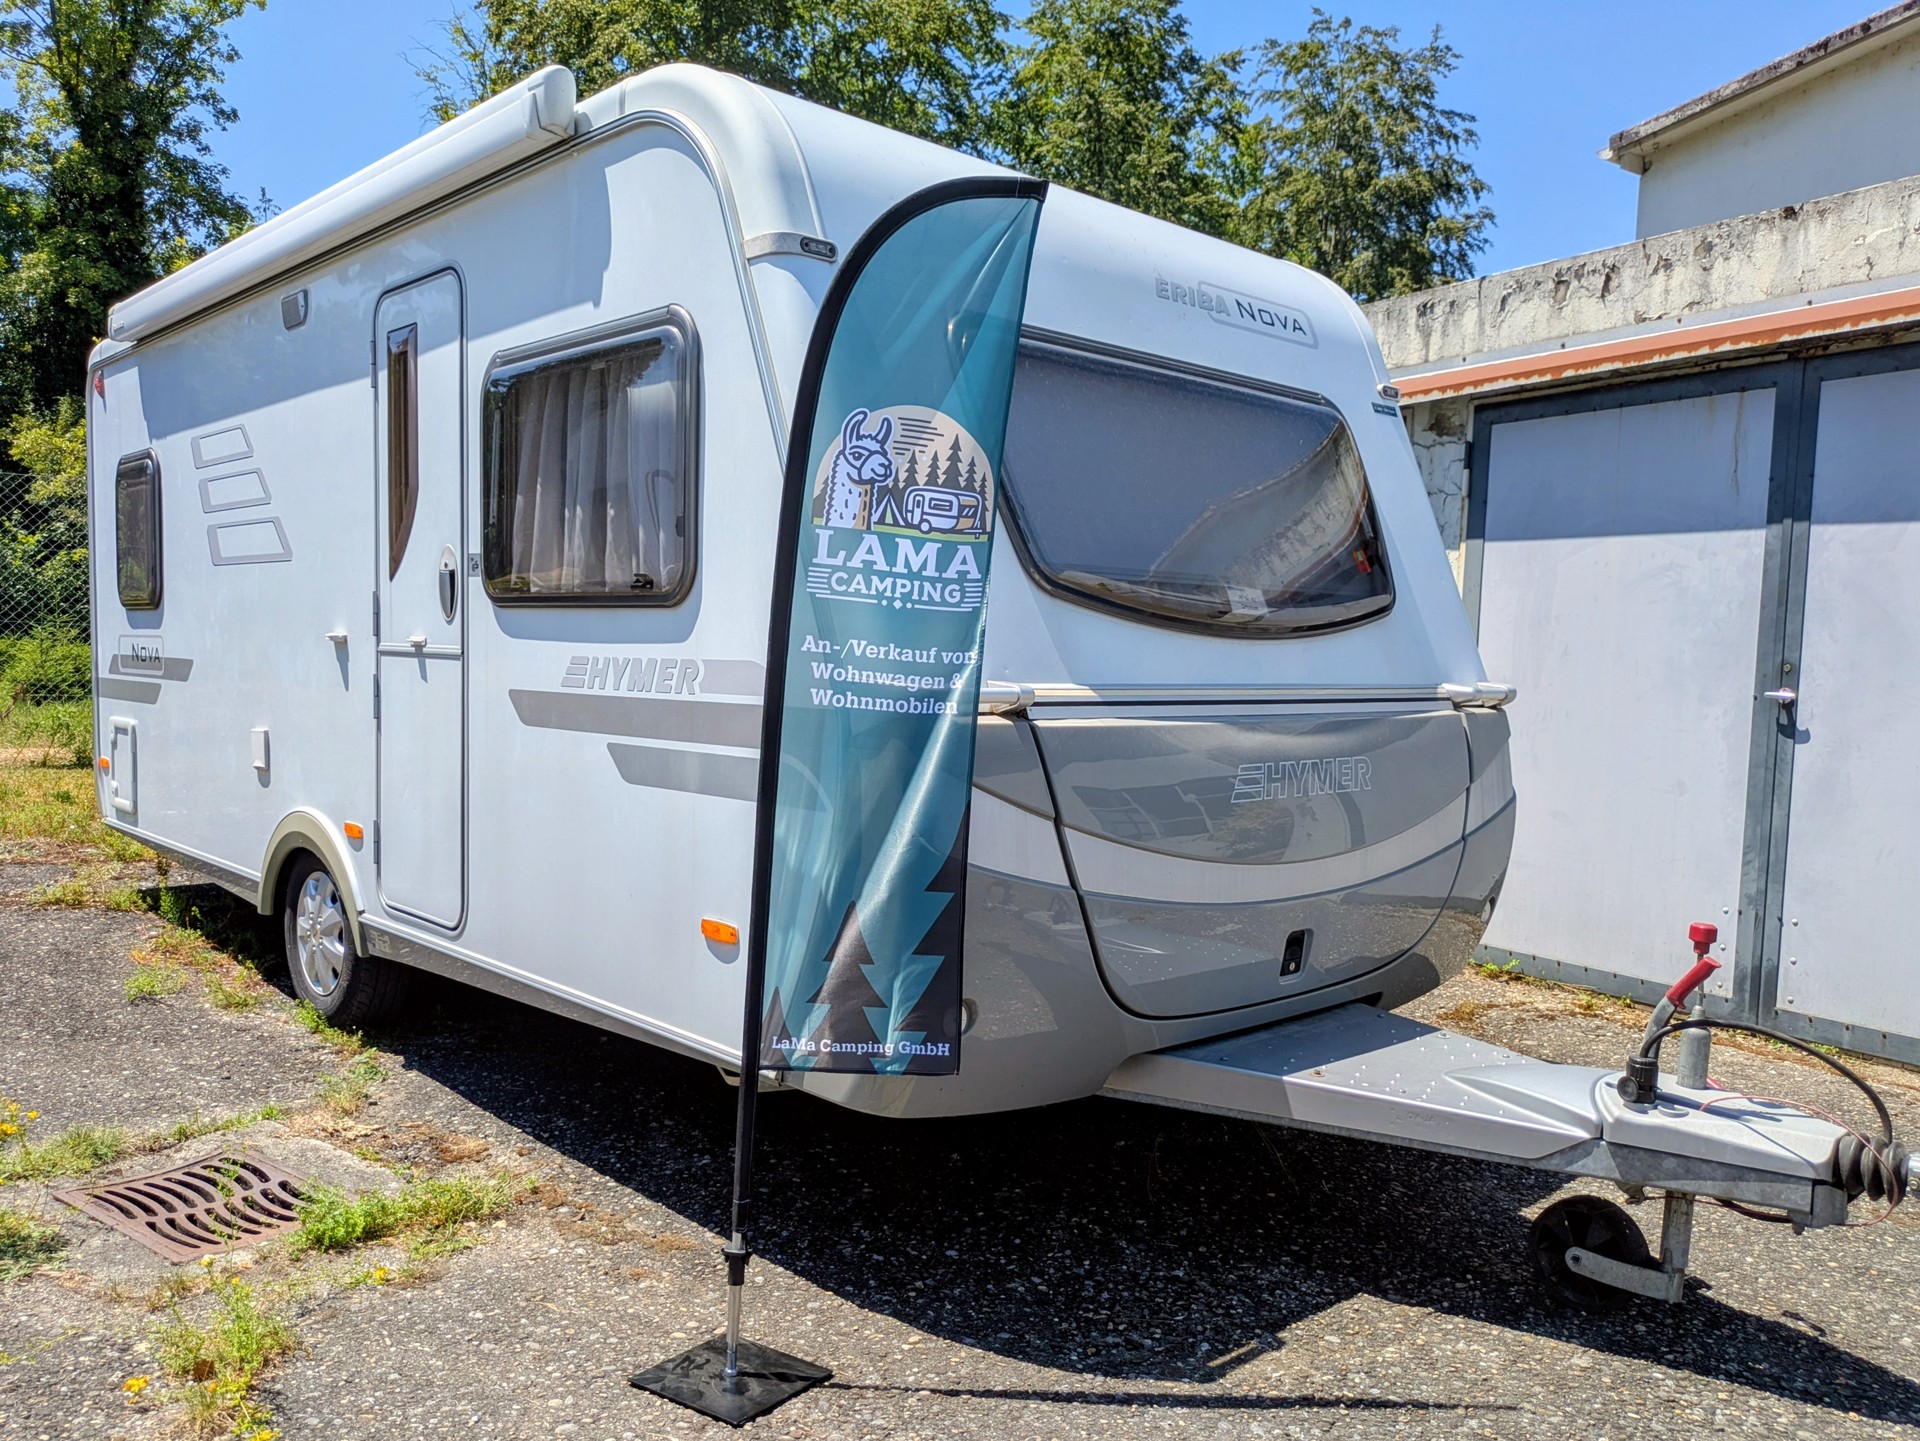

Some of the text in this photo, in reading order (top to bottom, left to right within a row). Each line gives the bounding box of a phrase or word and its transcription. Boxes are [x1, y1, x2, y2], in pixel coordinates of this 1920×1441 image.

[1155, 277, 1230, 317] ERIBA
[812, 529, 982, 579] LAMA
[831, 571, 962, 604] CAMPING
[801, 635, 936, 664] An-/Verkauf
[587, 656, 700, 695] HYMER
[811, 662, 963, 691] Wohnwagen &
[810, 688, 959, 715] Wohnmobilen
[1264, 756, 1372, 800] HYMER
[772, 1036, 950, 1056] LaMa Camping GmbH
